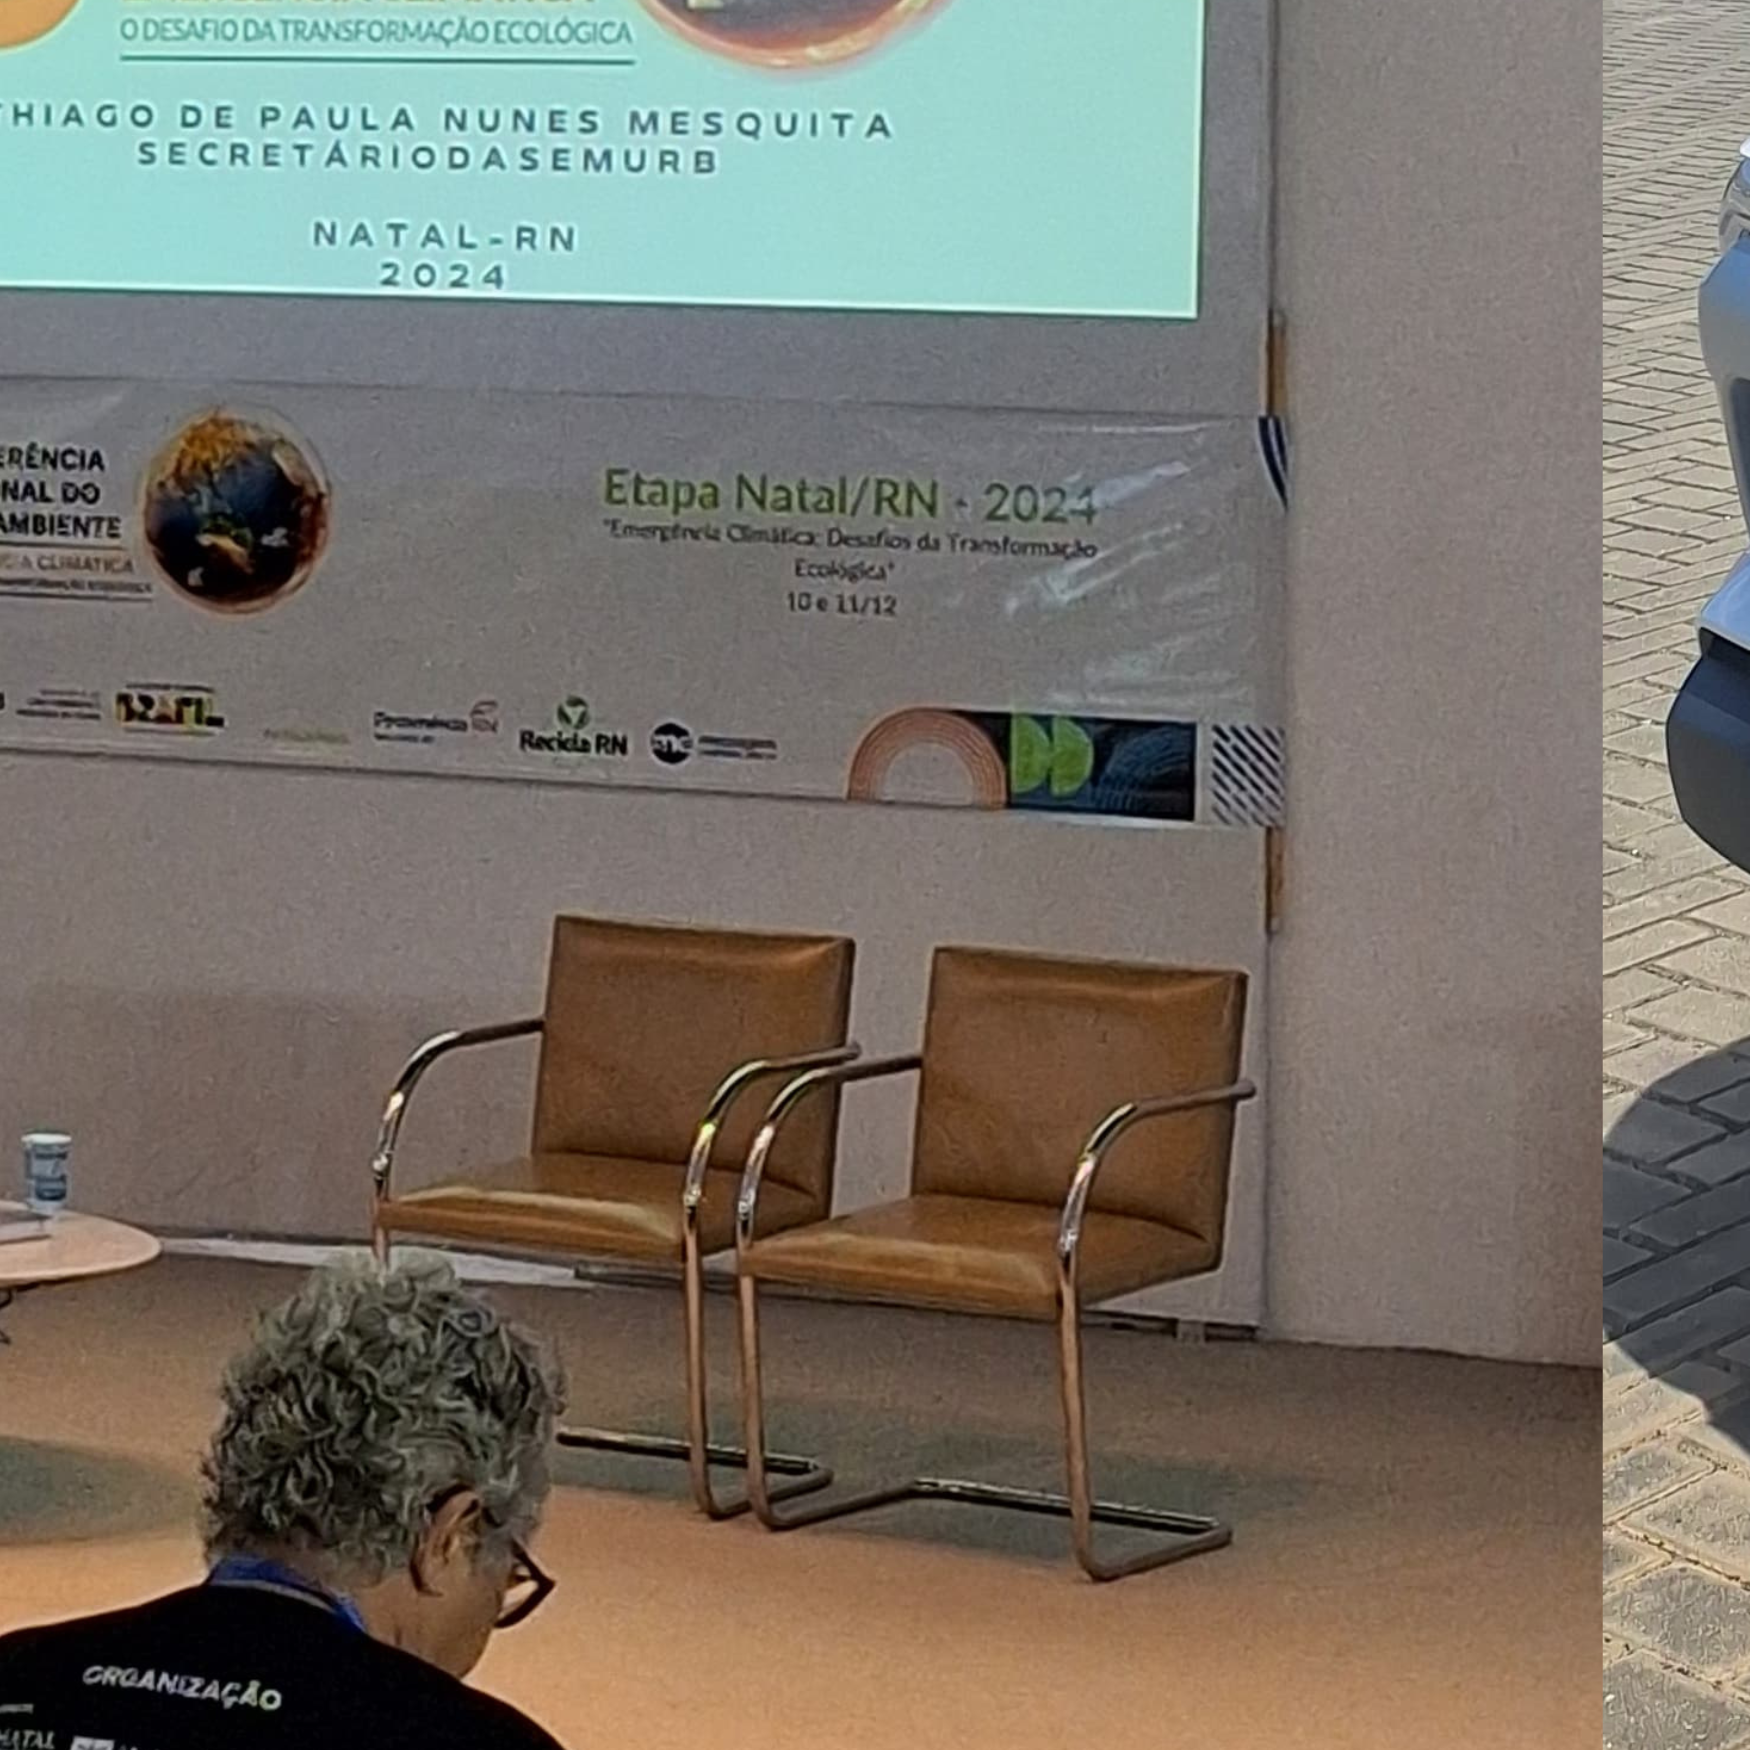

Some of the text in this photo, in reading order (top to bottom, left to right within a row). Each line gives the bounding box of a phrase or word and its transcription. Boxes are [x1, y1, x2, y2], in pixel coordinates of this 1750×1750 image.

[120, 16, 634, 48] O DESAFIO DA TRANSFORMAÇÃO ECOLÓGICA
[180, 105, 234, 130] DE
[260, 106, 415, 132] PAULA
[444, 108, 600, 134] NUNES
[629, 110, 892, 140] MESQUITA
[313, 220, 575, 252] NATAL-RN
[380, 261, 505, 290] 2024
[61, 482, 101, 506] DO
[604, 468, 719, 516] Etapa
[736, 472, 939, 519] Natal/RN
[983, 481, 1098, 526] 2024
[595, 732, 629, 756] RN
[81, 1664, 283, 1711] ORGANIZAÇÃO
